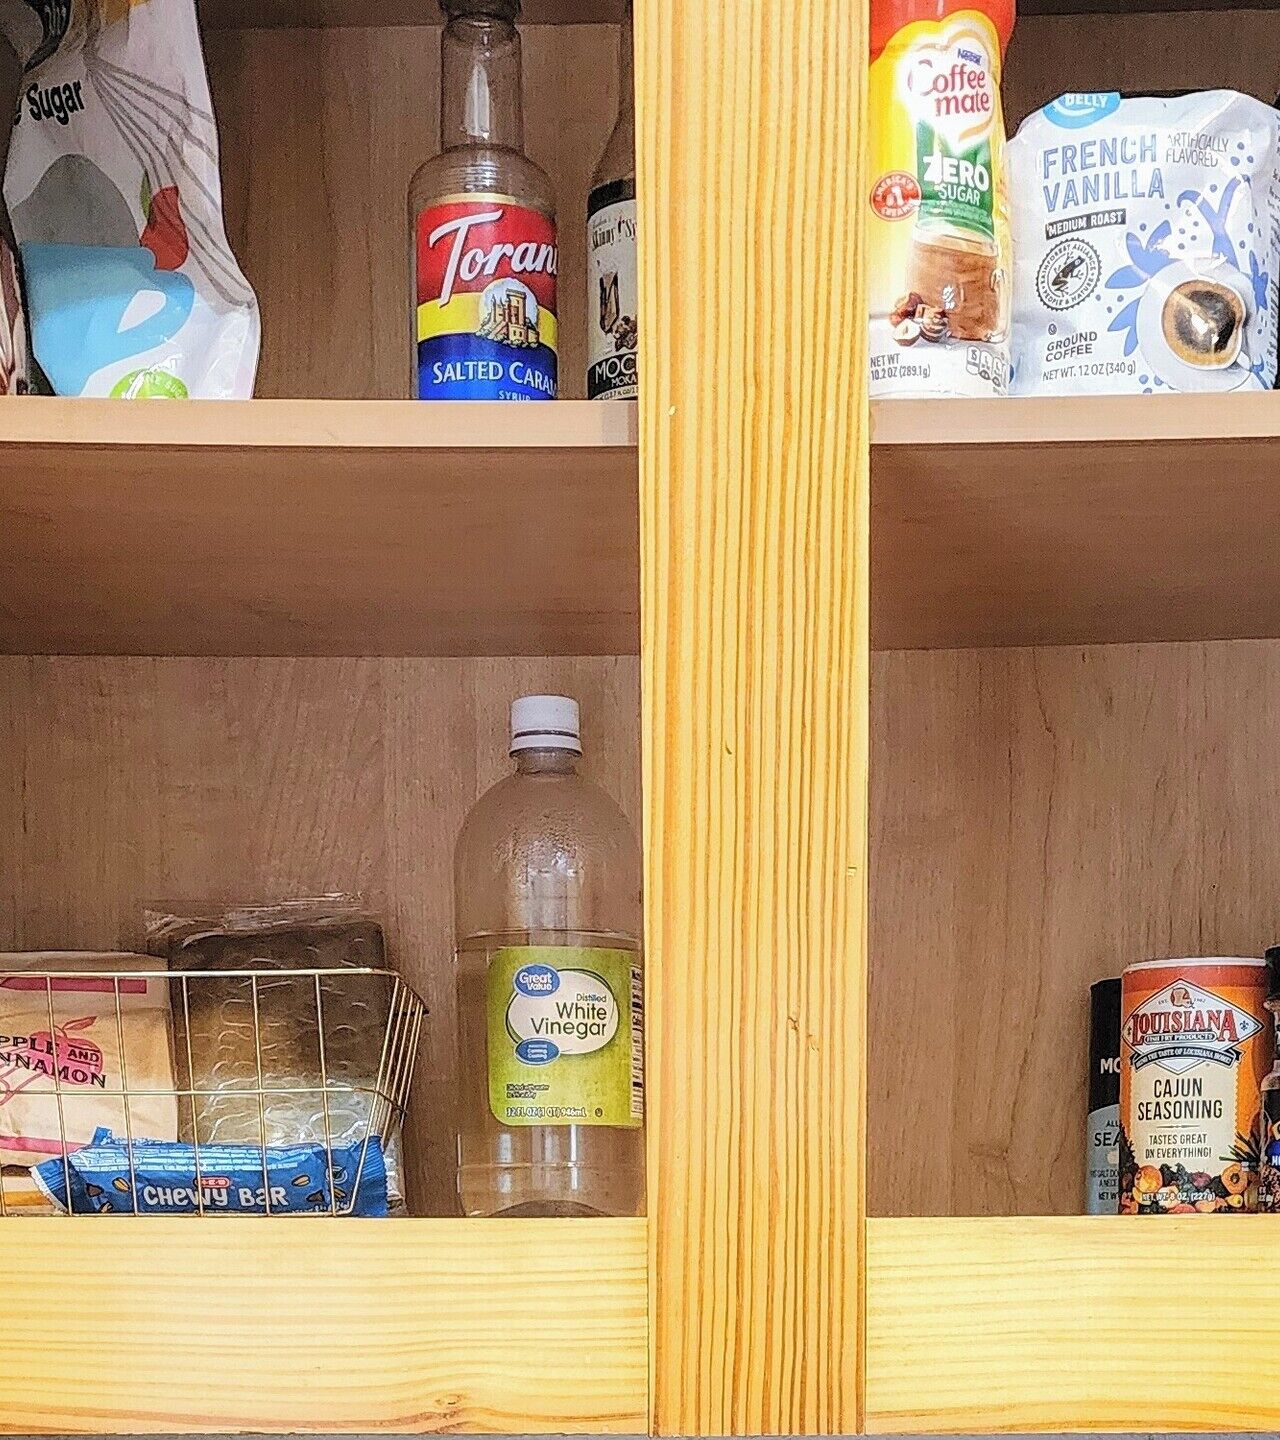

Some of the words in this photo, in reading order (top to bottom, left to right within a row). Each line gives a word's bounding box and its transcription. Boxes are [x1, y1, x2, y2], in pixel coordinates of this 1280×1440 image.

[26, 79, 83, 125] Sugar
[935, 90, 990, 117] mate
[1043, 134, 1157, 180] FRENCH
[923, 149, 989, 191] ZERO
[939, 184, 980, 205] SUGAR
[1043, 168, 1165, 212] VANILLA
[1047, 217, 1087, 237] MEDIUM
[1090, 210, 1123, 226] ROAST
[1047, 331, 1097, 352] GROUND
[870, 355, 887, 368] NET
[887, 353, 900, 365] WT
[1045, 344, 1093, 362] COFFEE
[433, 361, 503, 384] SALTED
[1043, 366, 1056, 381] NET
[1057, 365, 1076, 380] WT.
[1079, 366, 1090, 378] 12
[1091, 364, 1104, 376] OZ
[519, 972, 552, 984] Great
[527, 982, 553, 991] Value
[576, 993, 607, 1003] Distilled
[556, 1002, 607, 1020] White
[531, 1017, 607, 1039] Vinegar
[1131, 1010, 1239, 1046] LOUISIANA
[69, 1049, 99, 1062] AND
[1154, 1078, 1203, 1098] CAJUN
[1137, 1099, 1222, 1121] SEASONING
[1149, 1135, 1178, 1145] TASTES
[1180, 1133, 1207, 1144] GREAT
[1145, 1149, 1154, 1159] ON
[1157, 1147, 1212, 1158] EVERYTHING!
[1169, 1192, 1175, 1200] 8
